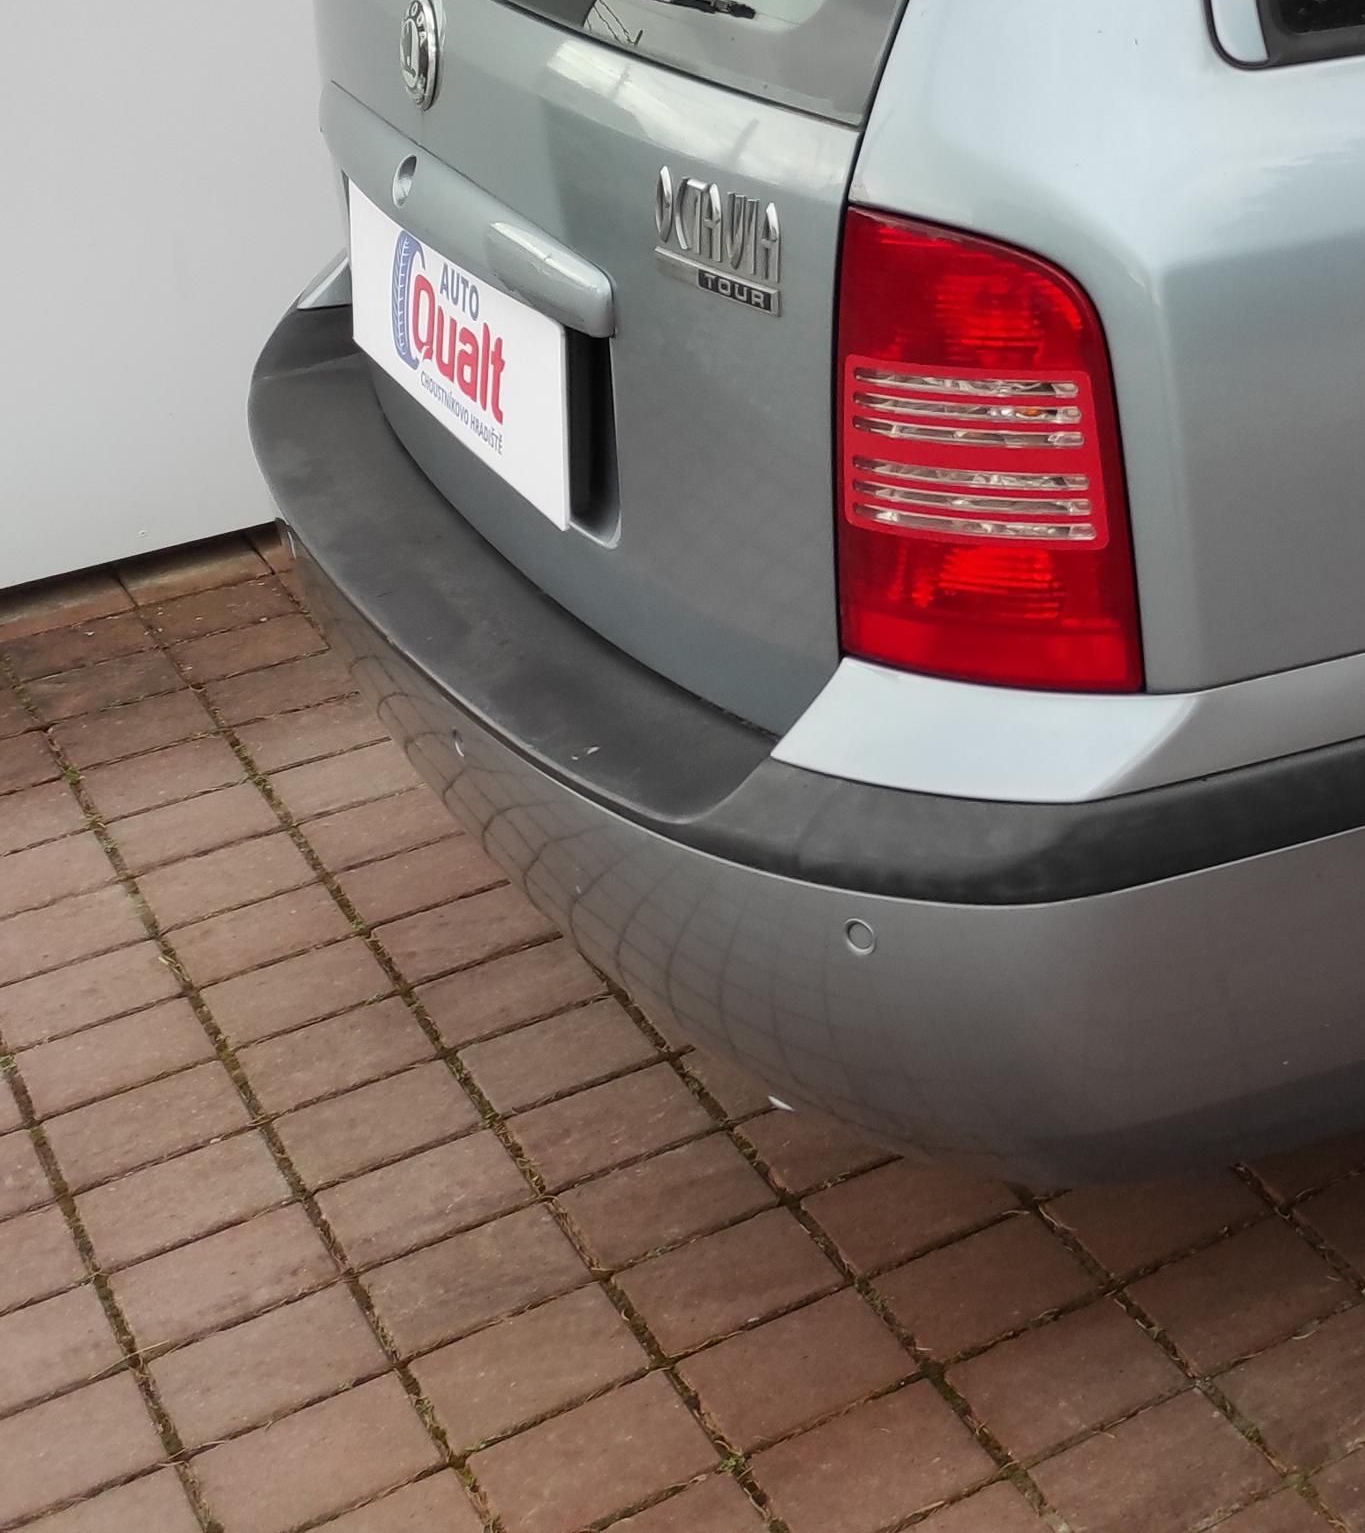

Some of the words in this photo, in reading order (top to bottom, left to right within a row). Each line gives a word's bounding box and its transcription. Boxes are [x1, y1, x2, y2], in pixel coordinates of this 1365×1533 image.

[440, 262, 480, 321] AUTO
[703, 272, 766, 309] TOUR
[412, 273, 506, 426] Qualt
[420, 371, 469, 426] CHOUSTNÍKOVO
[469, 412, 503, 456] HRADIŠTĚ
